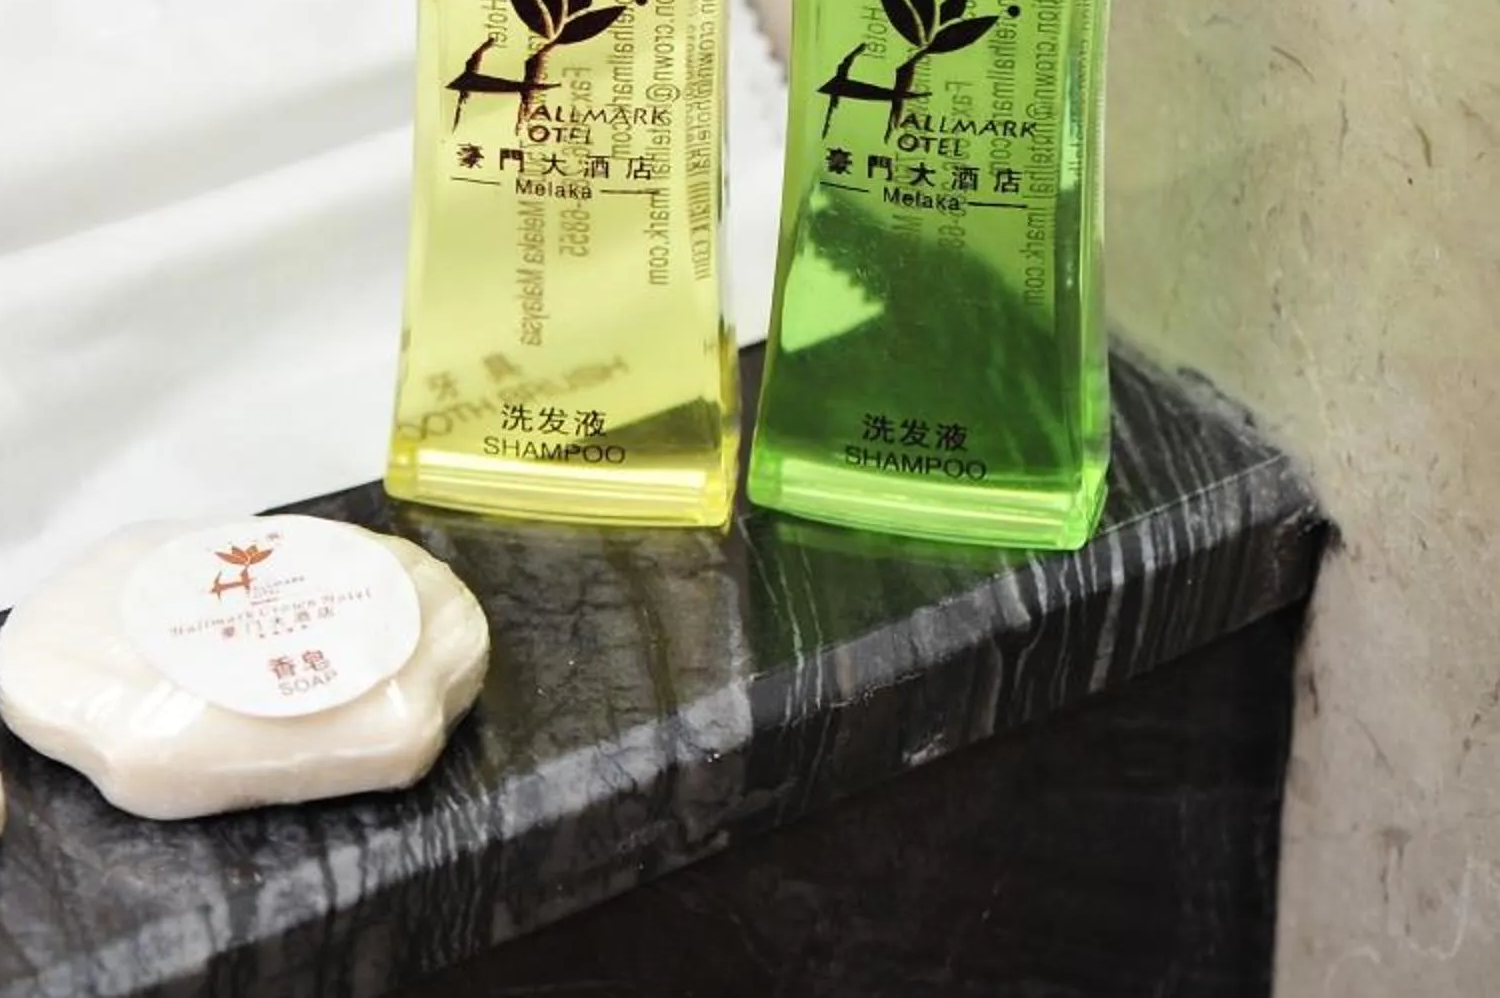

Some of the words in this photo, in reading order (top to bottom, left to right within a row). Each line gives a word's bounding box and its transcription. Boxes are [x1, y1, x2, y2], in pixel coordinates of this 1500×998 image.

[514, 178, 594, 201] Melaka
[883, 186, 962, 212] Melaka
[500, 402, 609, 439] 洗发液
[862, 412, 970, 452] 洗发液
[482, 435, 628, 465] SHAMPOO
[844, 445, 989, 482] SHAMPOO
[278, 669, 339, 697] SOAP
